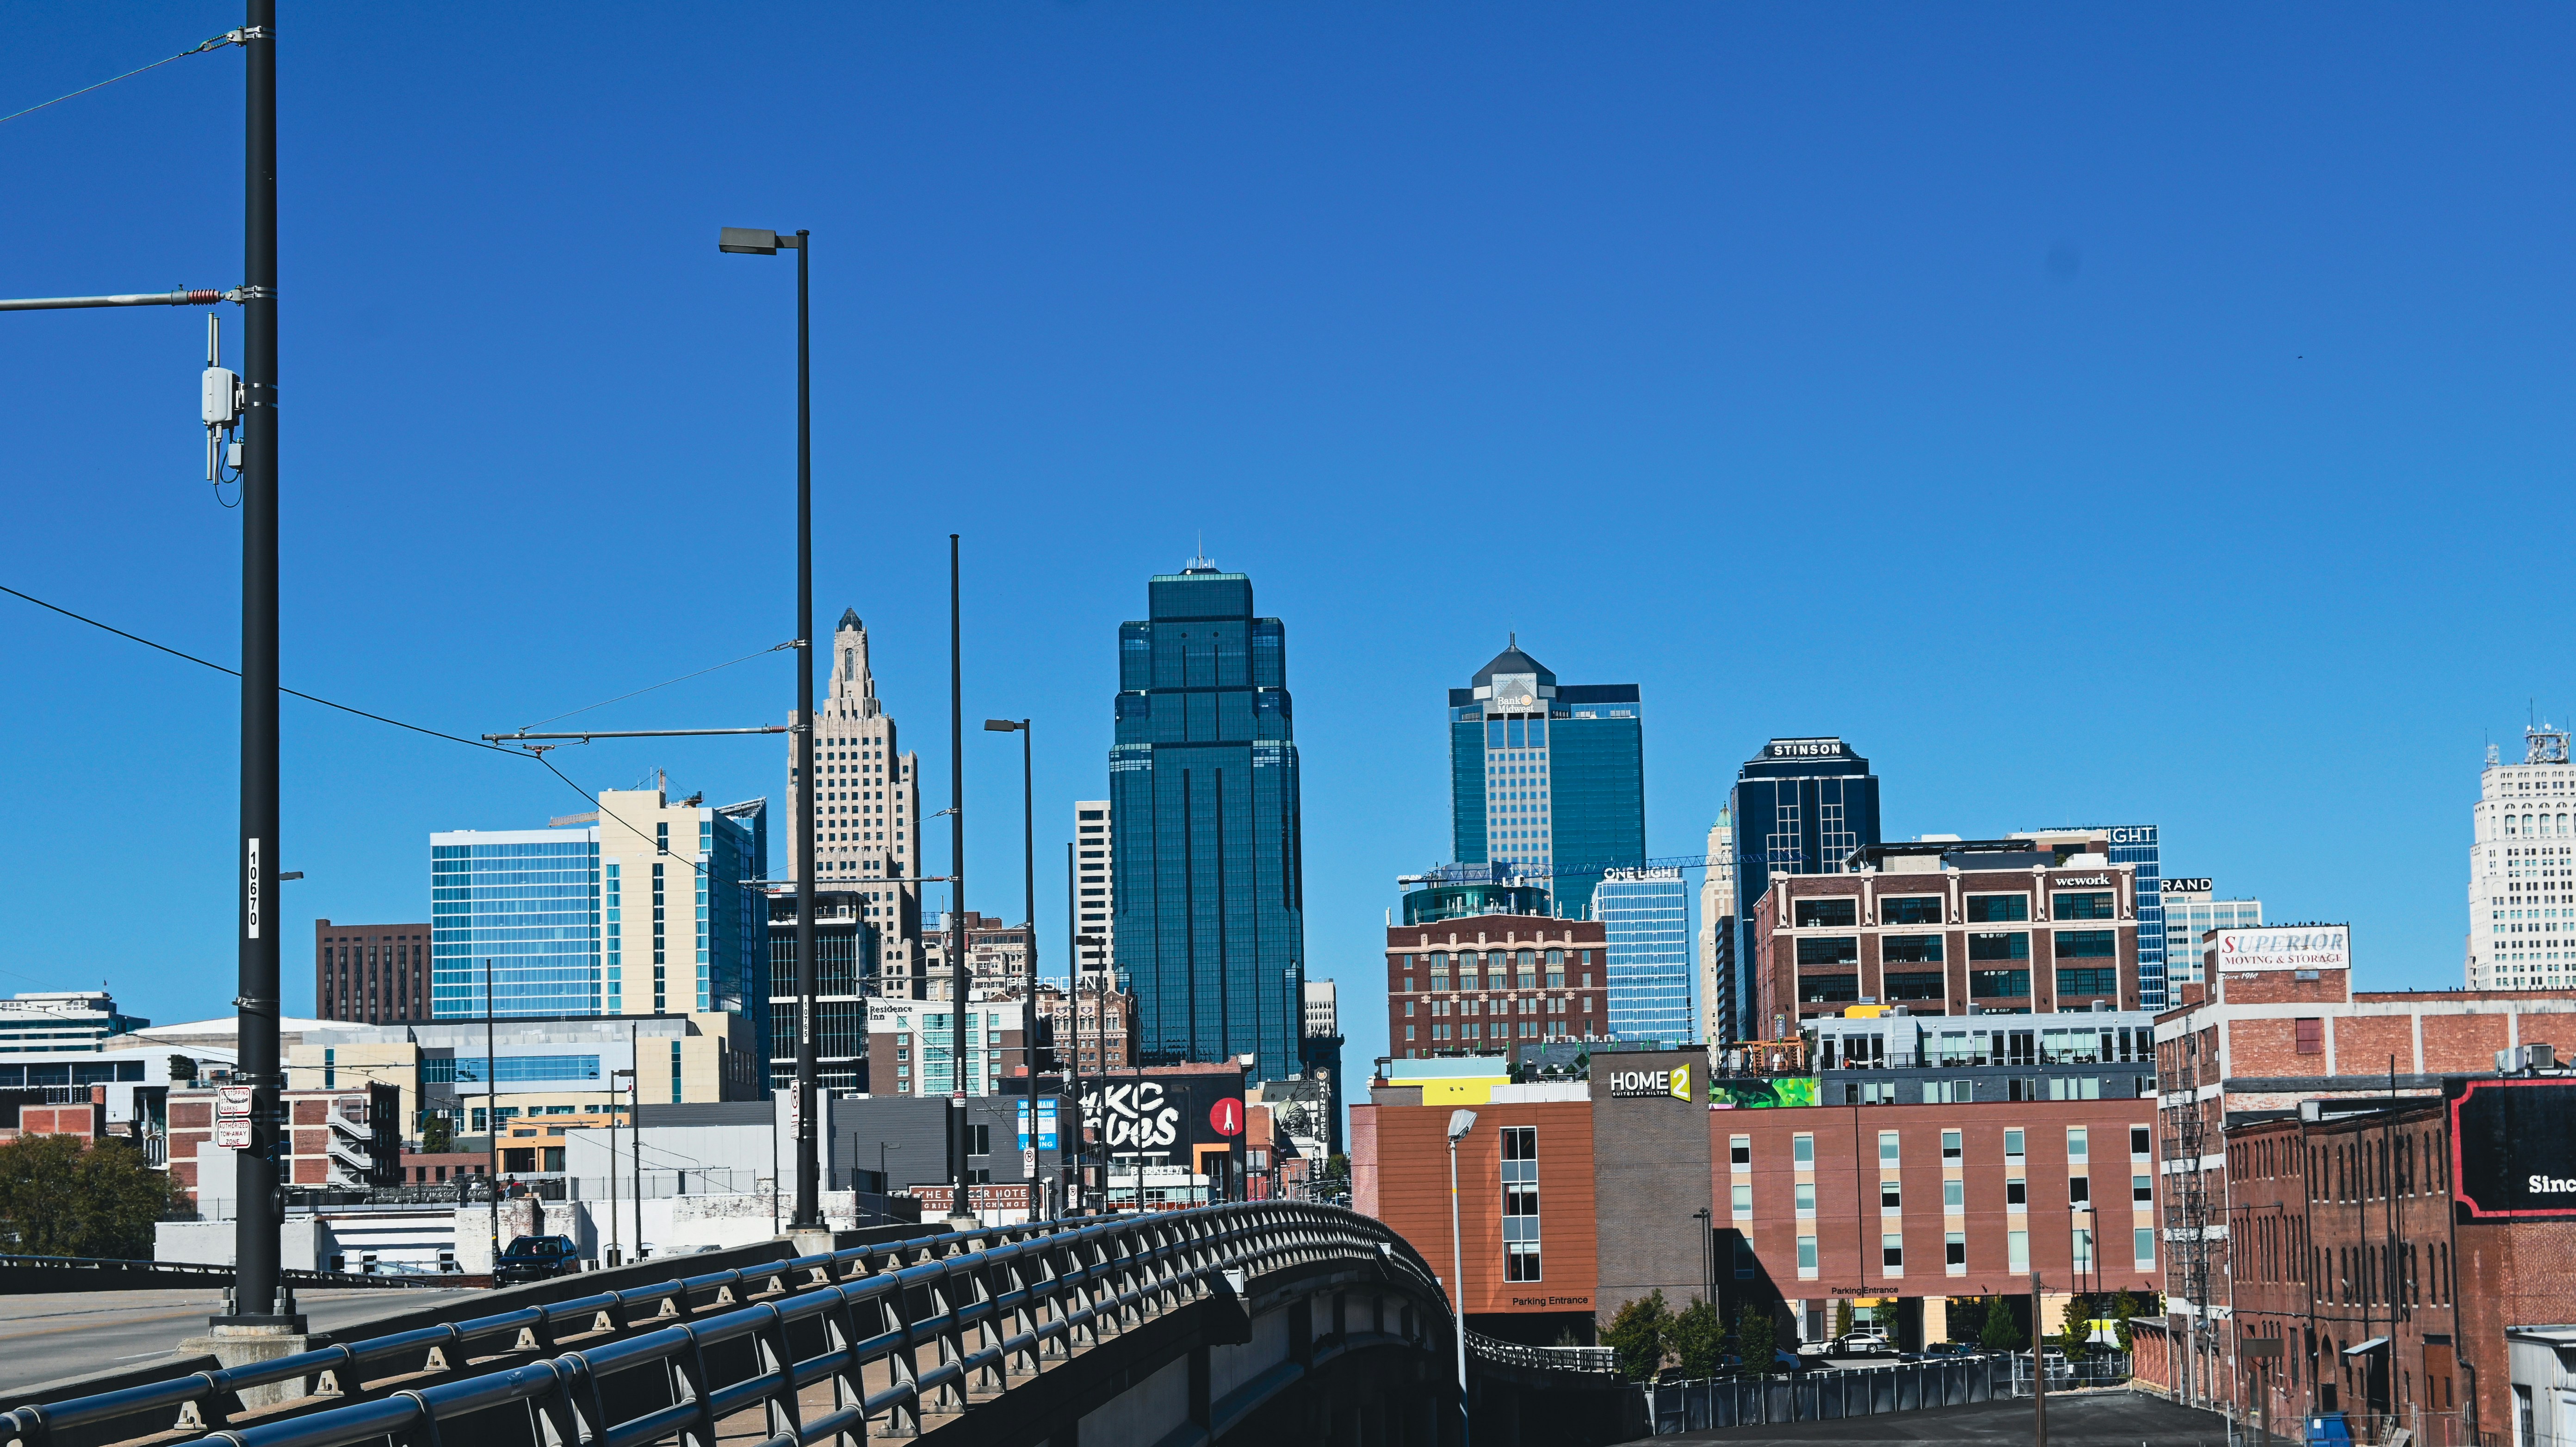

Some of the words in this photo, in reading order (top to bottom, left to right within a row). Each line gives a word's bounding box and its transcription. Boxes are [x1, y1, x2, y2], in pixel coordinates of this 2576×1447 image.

[1497, 696, 1521, 705] Bank
[1497, 704, 1534, 713] Midwest
[1774, 744, 1840, 756] STINSON
[1604, 867, 1634, 879] ONE
[1638, 866, 1680, 878] LIGHT
[2055, 872, 2111, 886] wework
[2222, 934, 2344, 953] SUPERIOR
[2225, 956, 2273, 965] MOVING
[2276, 955, 2285, 964] &
[2288, 953, 2343, 964] STORAGE
[1610, 1071, 1669, 1090] HOME
[1672, 1069, 1689, 1098] 2
[919, 1190, 941, 1199] THE
[1832, 1287, 1862, 1296] Parking
[1512, 1297, 1546, 1307] Parking
